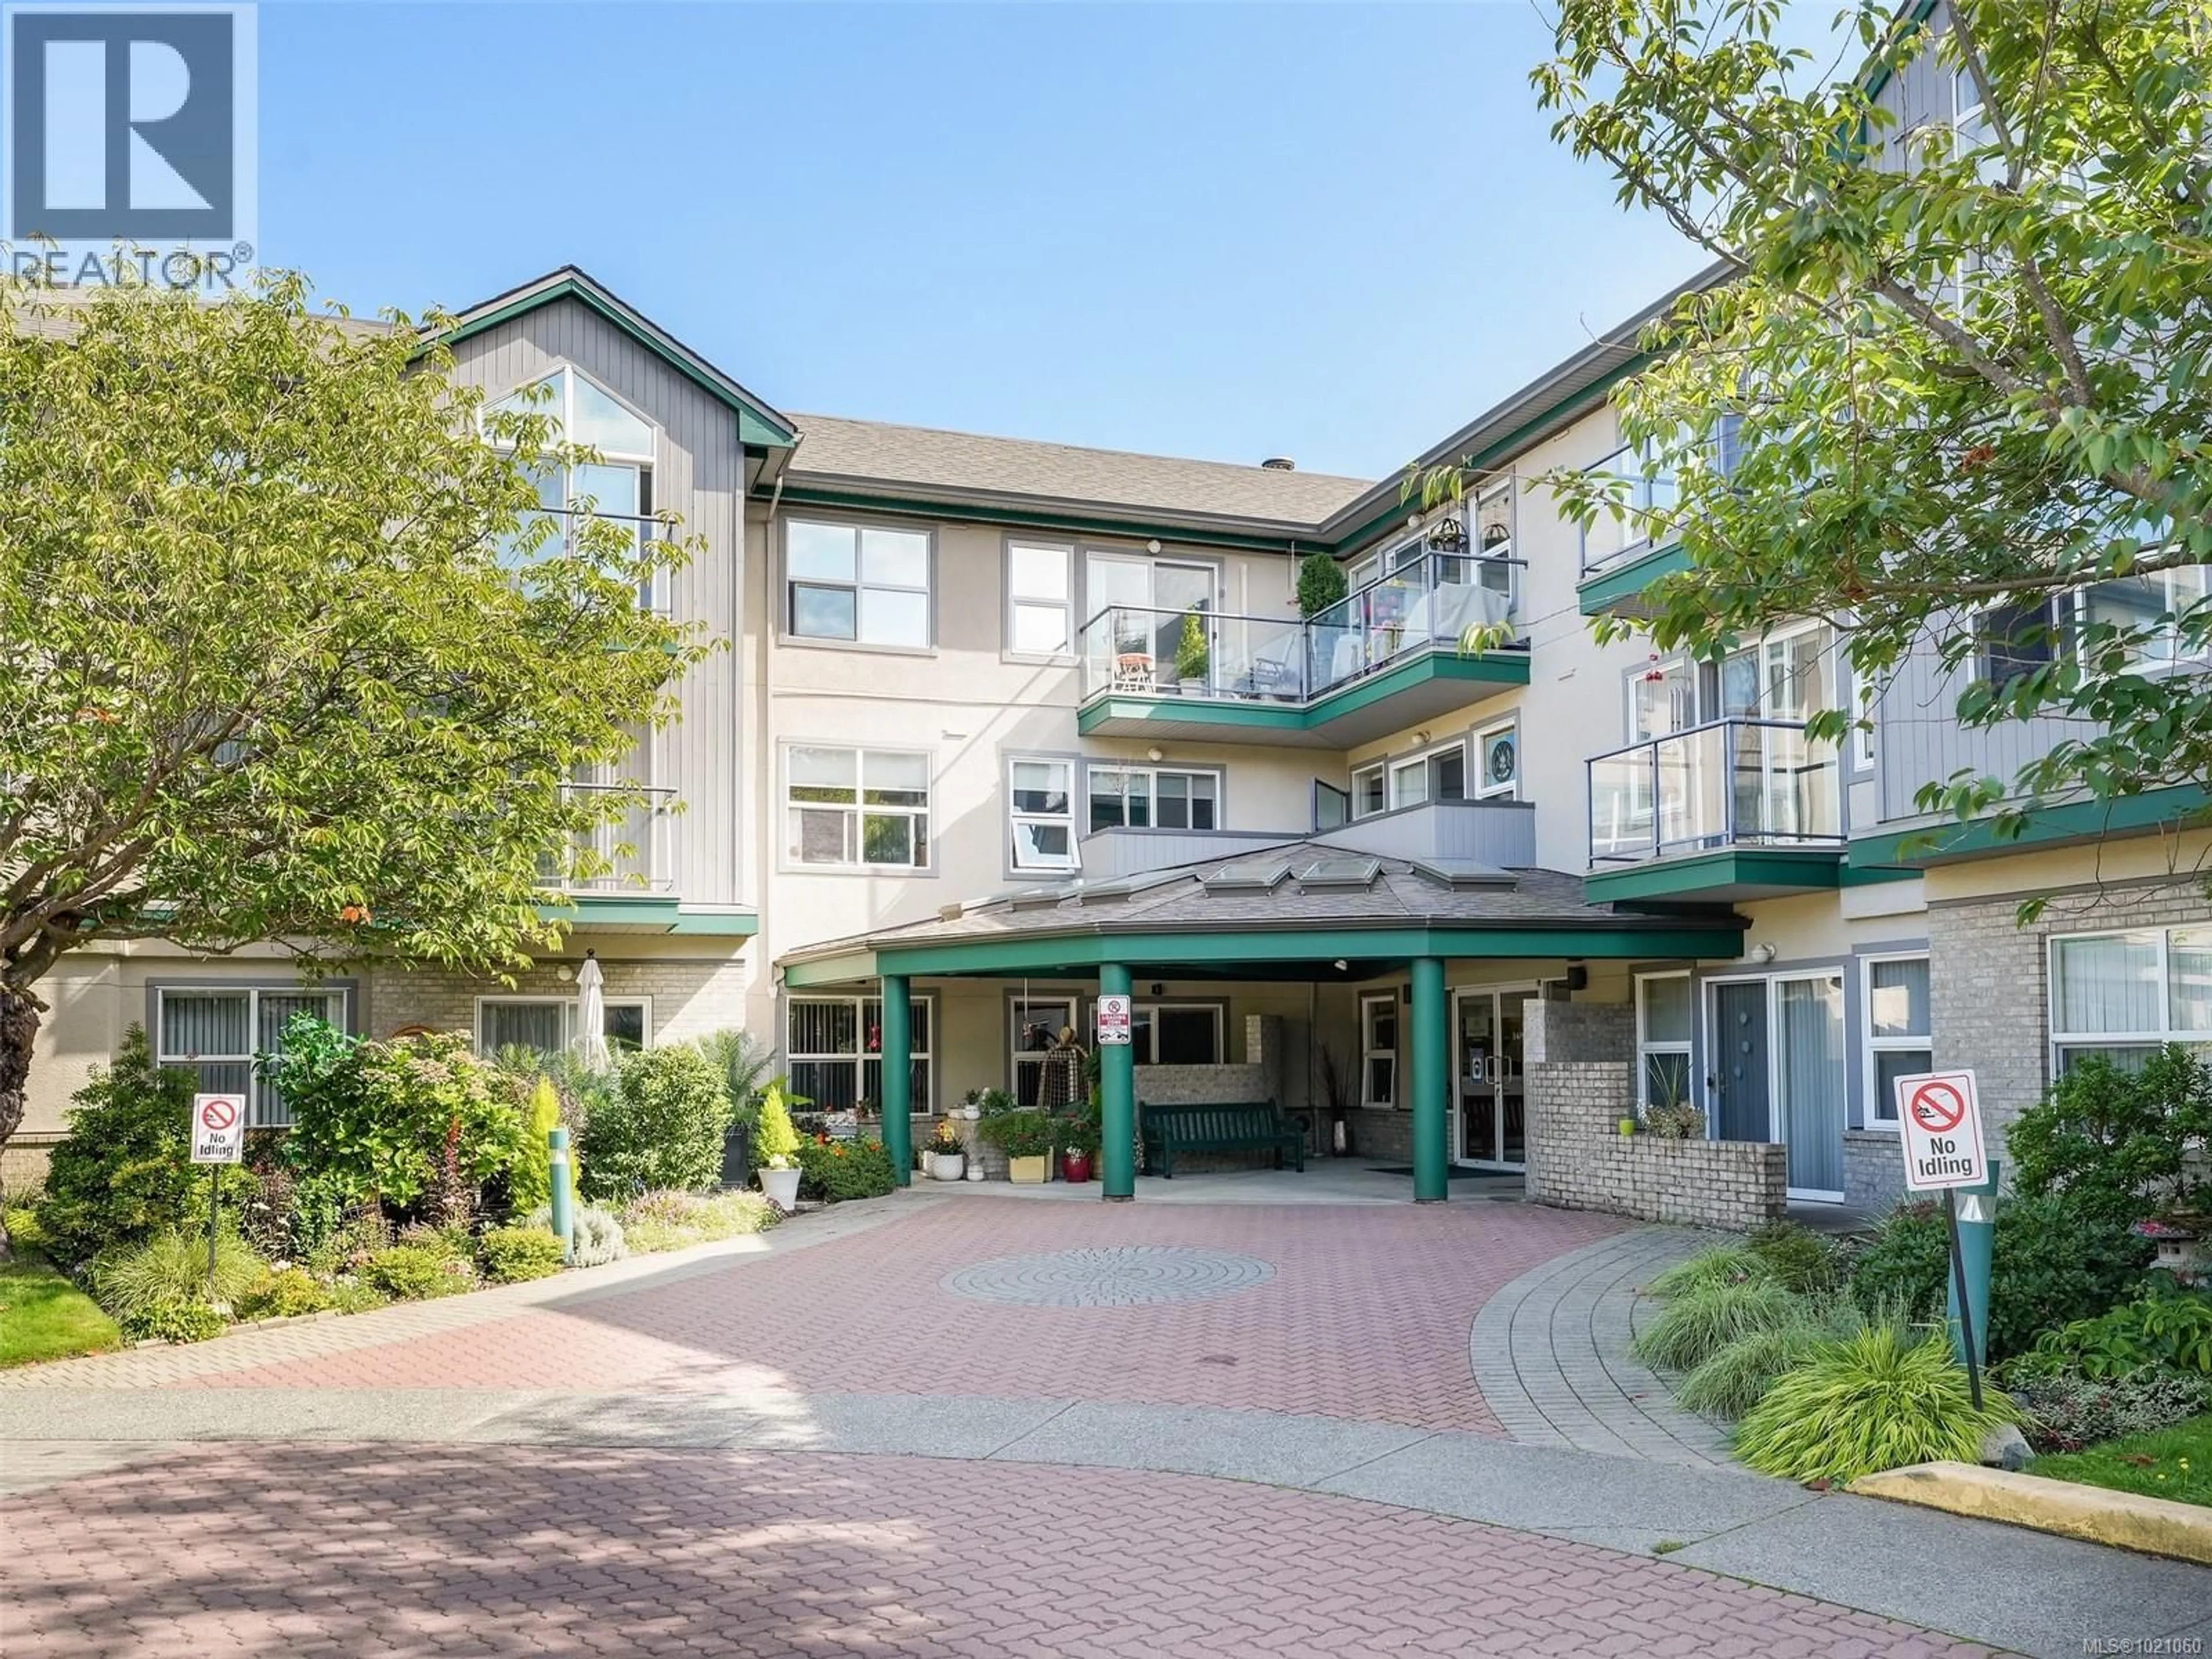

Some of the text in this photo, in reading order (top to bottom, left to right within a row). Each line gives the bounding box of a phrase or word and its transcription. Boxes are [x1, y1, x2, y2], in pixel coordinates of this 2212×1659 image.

[210, 1133, 226, 1143] No
[200, 1145, 233, 1156] Idling
[1930, 1137, 1956, 1154] No
[1919, 1156, 1972, 1176] Idling
